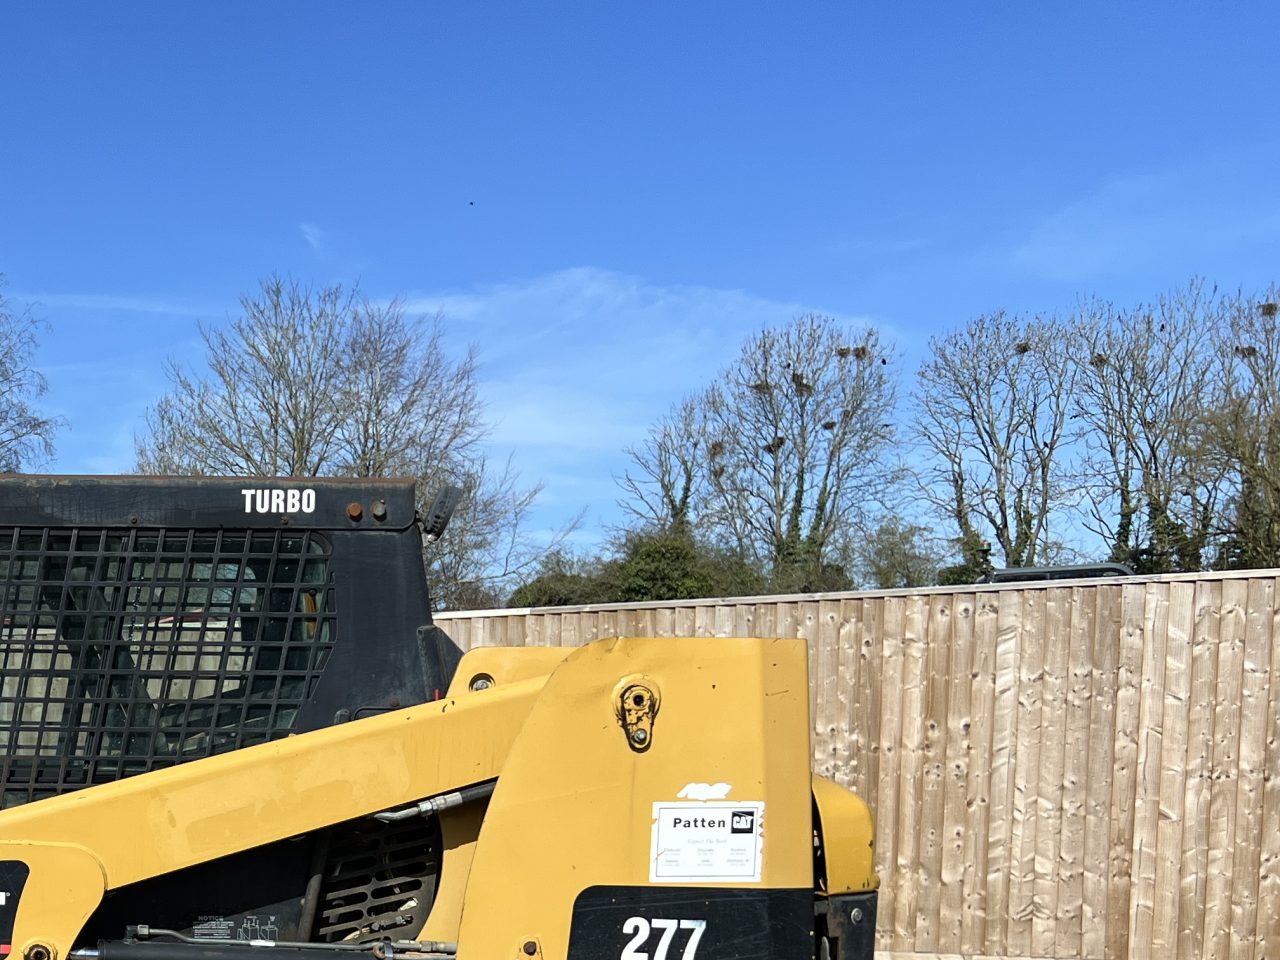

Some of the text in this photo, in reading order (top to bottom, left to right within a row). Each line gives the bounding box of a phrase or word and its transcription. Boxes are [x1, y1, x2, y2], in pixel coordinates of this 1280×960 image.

[241, 488, 317, 514] TURBO
[672, 815, 754, 829] Patten CAT
